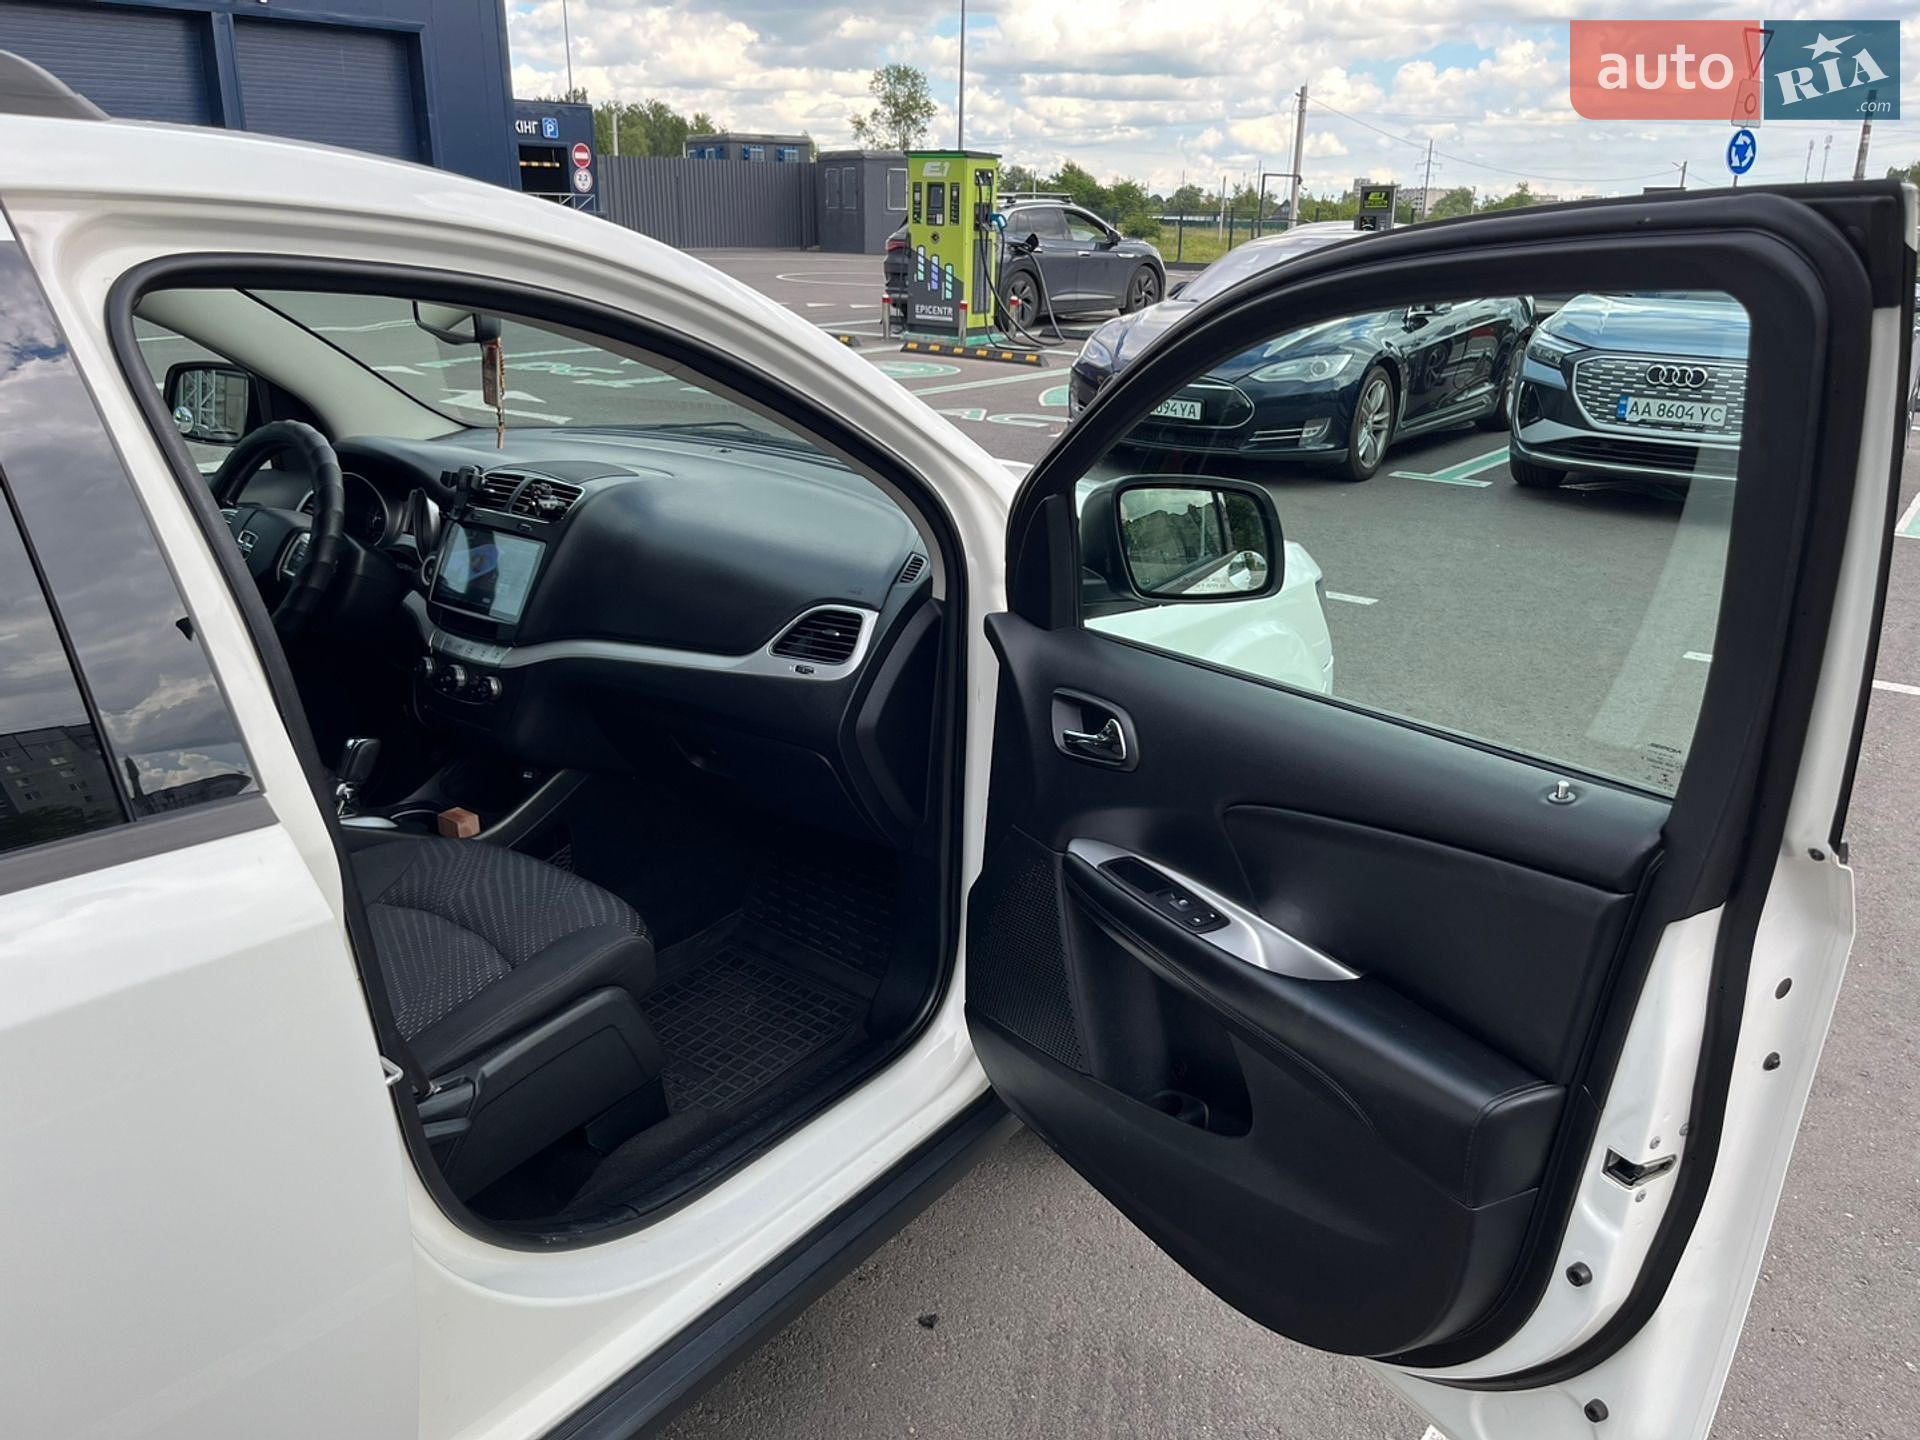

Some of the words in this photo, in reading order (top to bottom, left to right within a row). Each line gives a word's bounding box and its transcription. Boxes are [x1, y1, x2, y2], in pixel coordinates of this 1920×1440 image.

[914, 303, 953, 316] EPICENTR
[1180, 403, 1196, 417] YA
[1629, 401, 1652, 417] AA
[1656, 403, 1695, 421] 8604
[1699, 406, 1723, 423] YC
